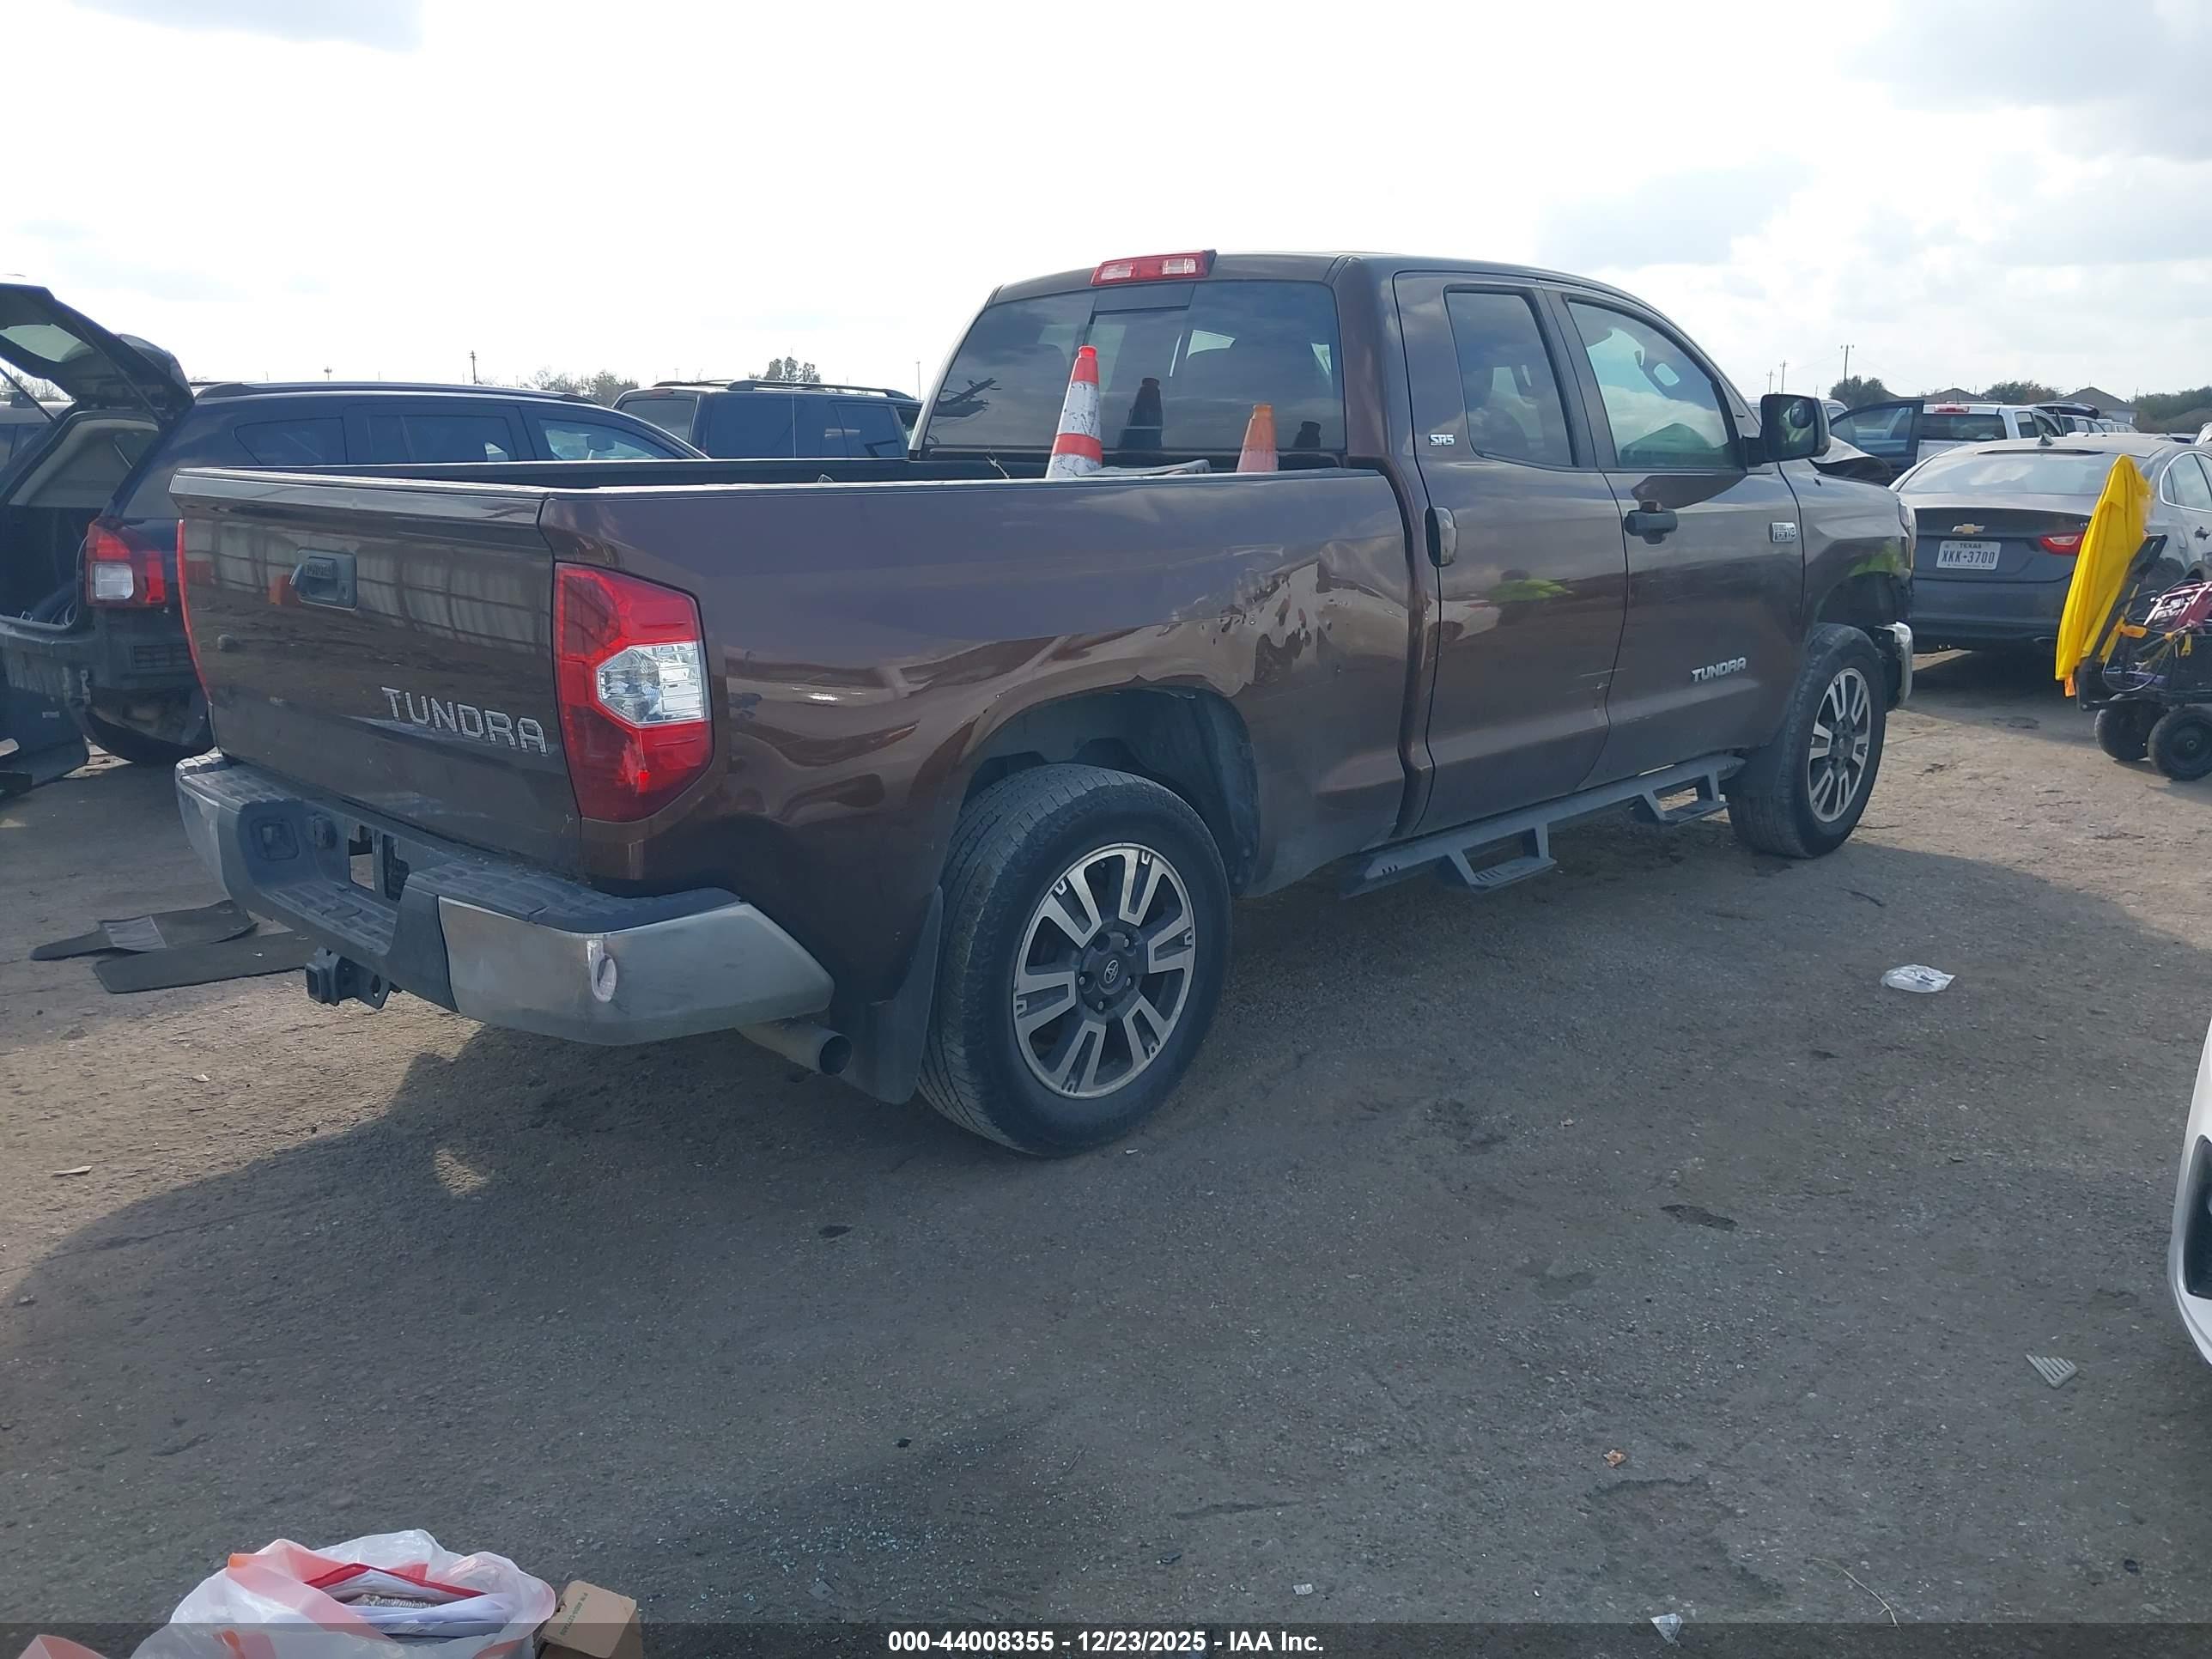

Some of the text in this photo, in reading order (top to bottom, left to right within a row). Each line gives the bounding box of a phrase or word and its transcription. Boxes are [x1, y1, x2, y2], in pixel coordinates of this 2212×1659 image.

[1430, 434, 1455, 446] SR5
[1691, 657, 1747, 682] TUNDRA
[381, 686, 548, 756] TUNDRA
